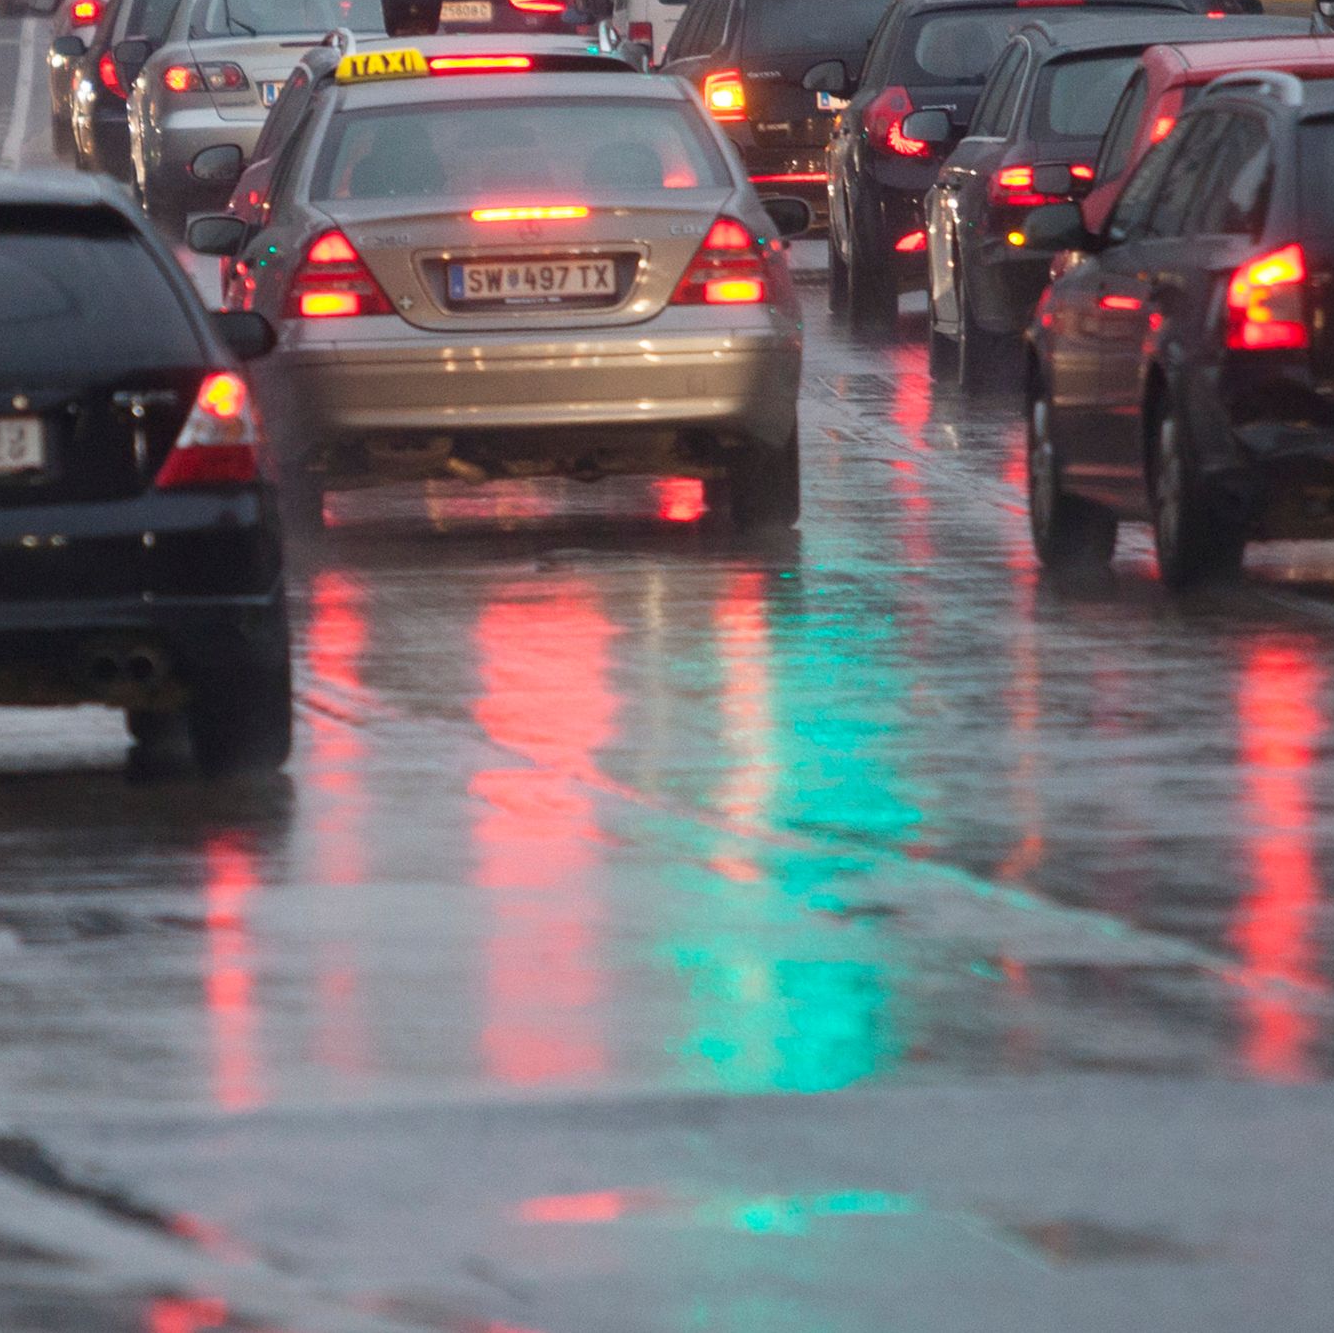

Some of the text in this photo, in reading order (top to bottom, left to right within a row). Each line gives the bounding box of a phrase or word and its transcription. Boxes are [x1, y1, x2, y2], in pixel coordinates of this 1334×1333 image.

[350, 52, 415, 76] TAXI
[469, 268, 608, 294] SW 497 TX
